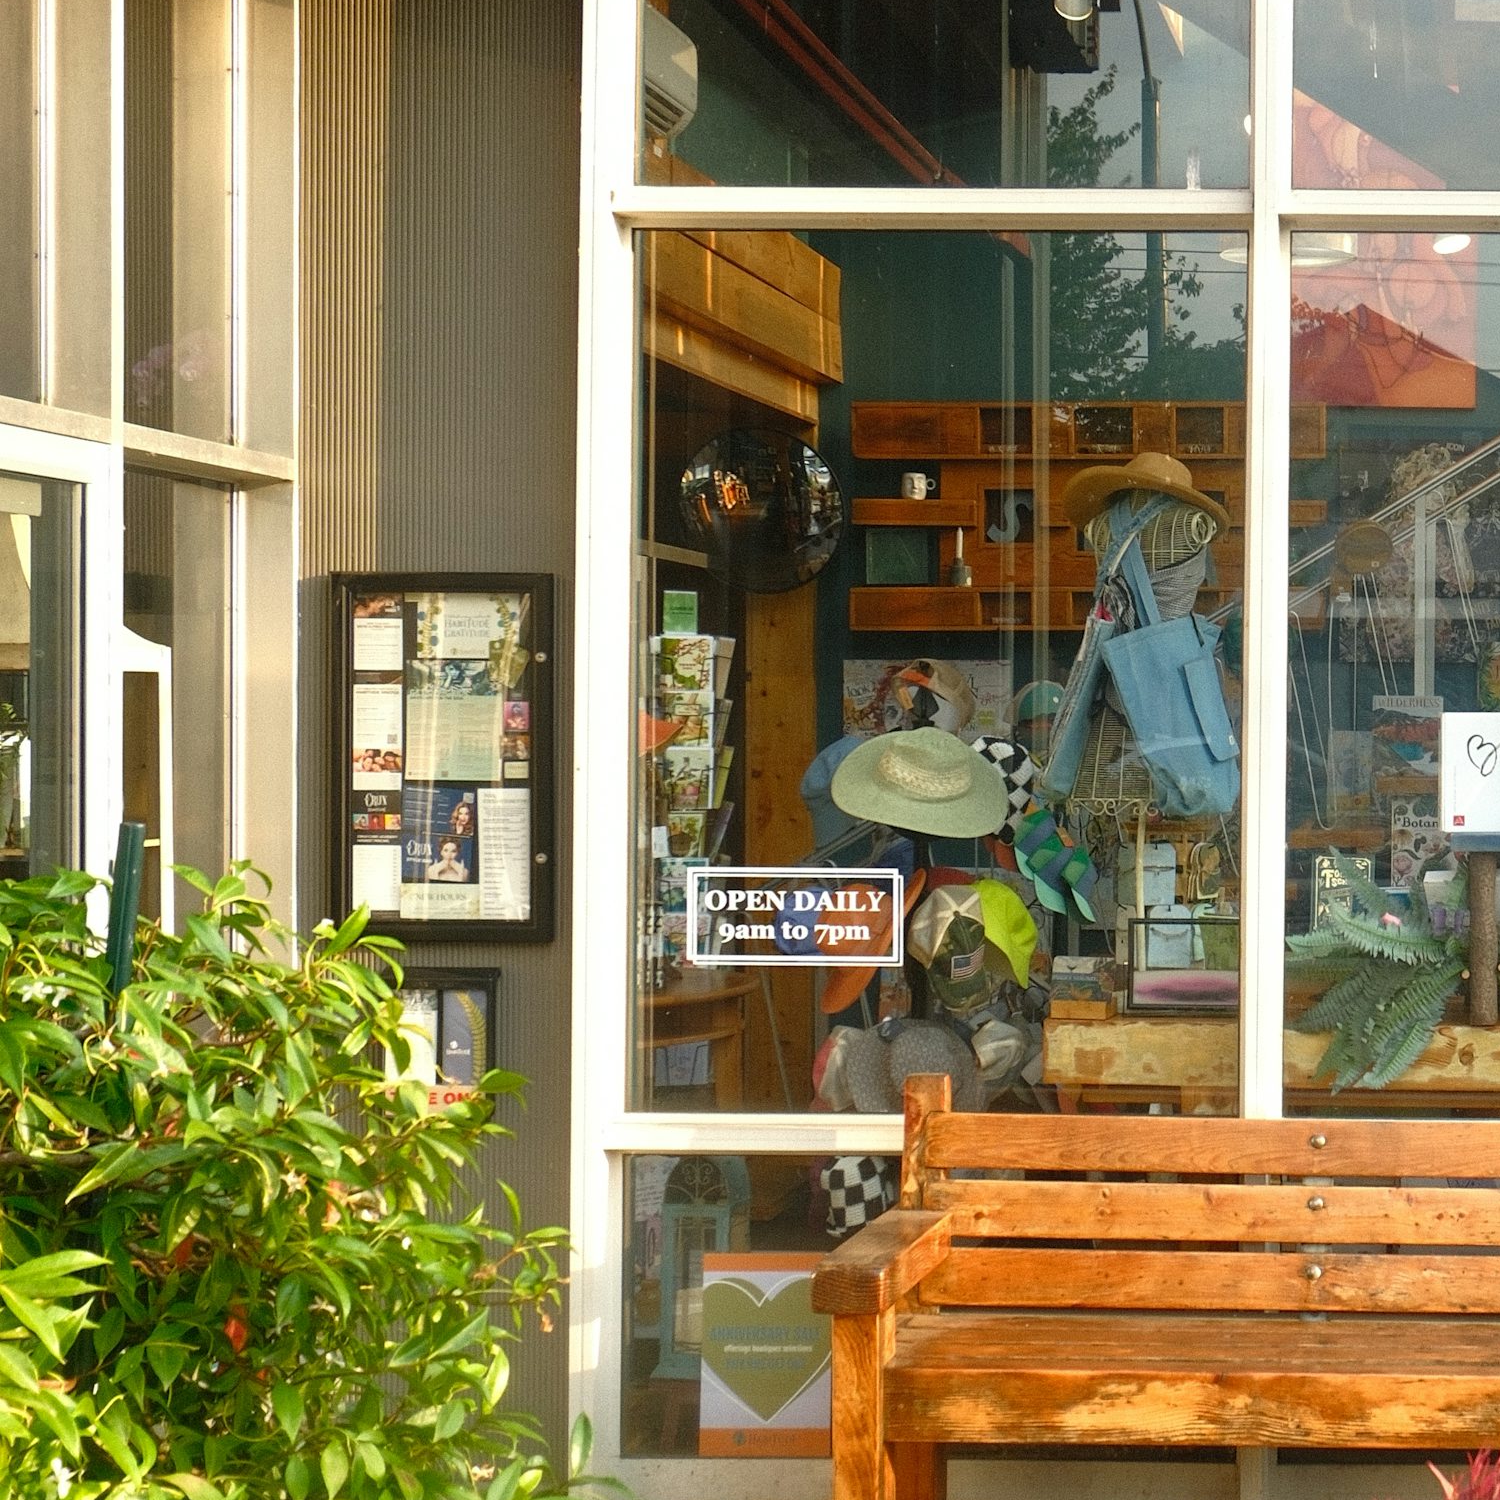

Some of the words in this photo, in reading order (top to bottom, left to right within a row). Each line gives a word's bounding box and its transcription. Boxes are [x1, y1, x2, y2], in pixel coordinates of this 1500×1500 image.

[704, 889, 787, 911] OPEN
[793, 890, 887, 912] DAILY
[718, 923, 776, 943] 9am
[781, 921, 809, 940] to
[813, 924, 871, 946] 7pm
